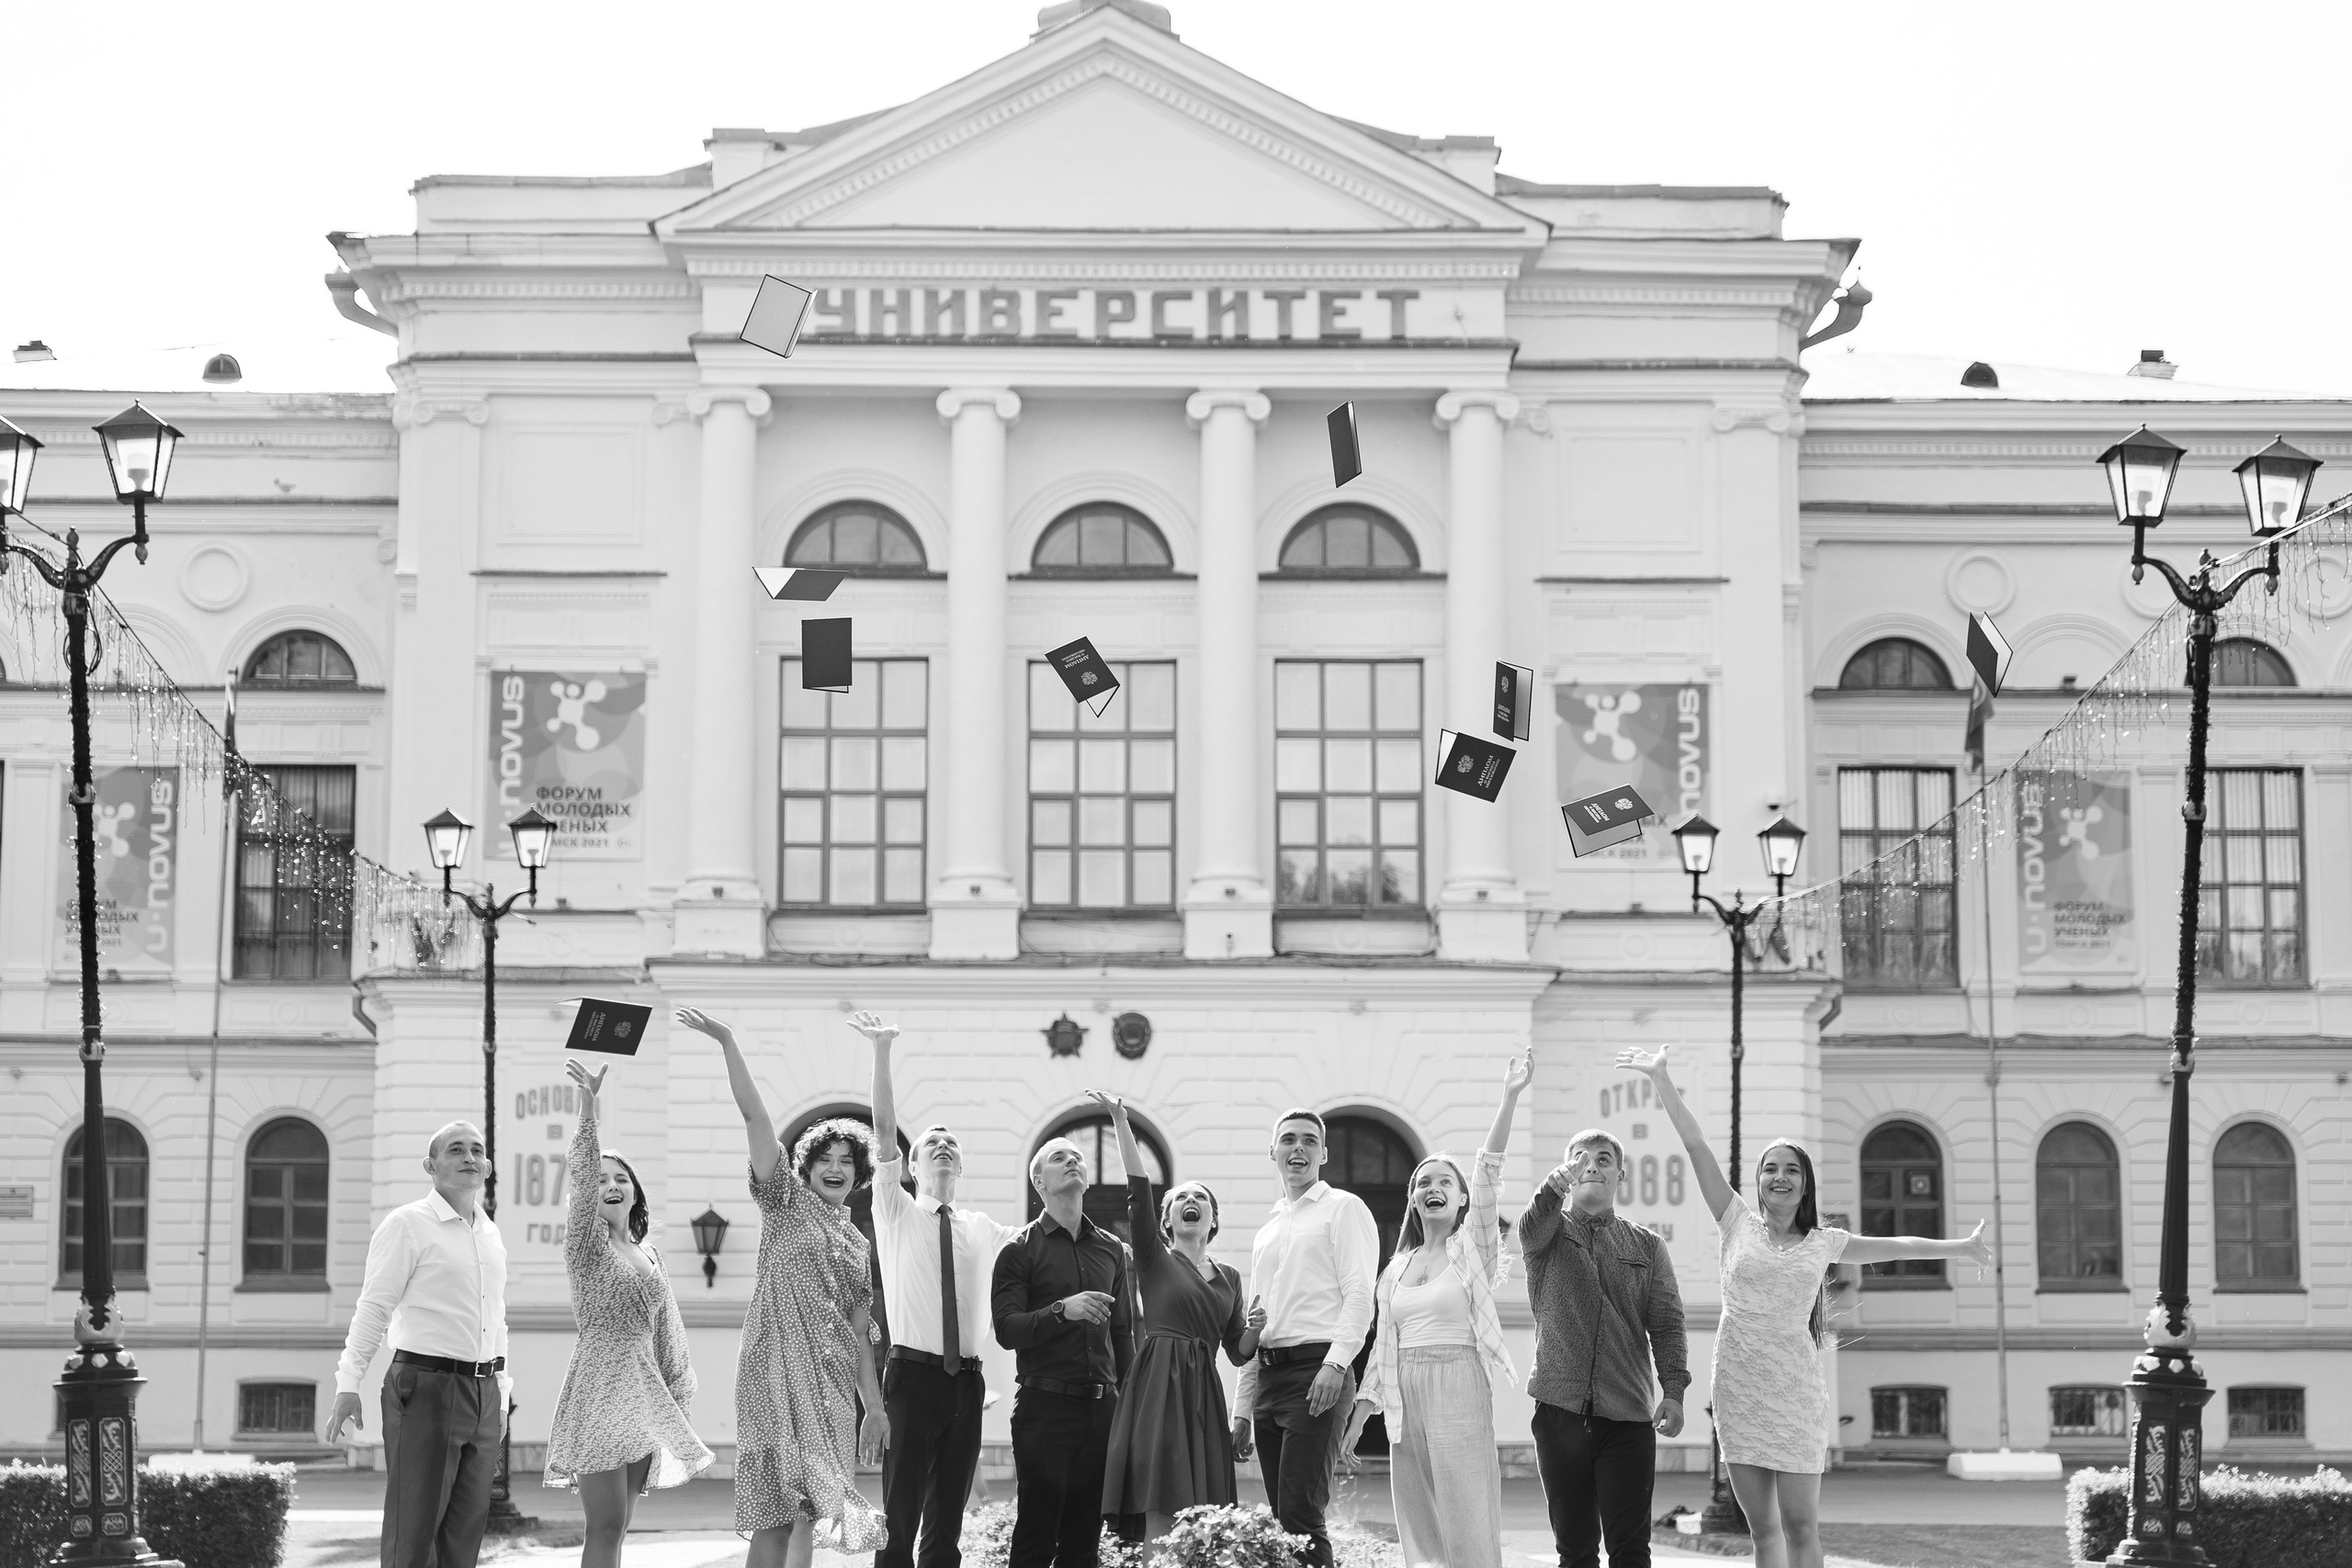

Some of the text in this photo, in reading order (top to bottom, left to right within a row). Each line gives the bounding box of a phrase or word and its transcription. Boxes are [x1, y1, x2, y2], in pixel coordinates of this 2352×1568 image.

[814, 288, 1420, 340] УНИВЕРСИТЕТ
[1064, 654, 1090, 669] ДИПЛОМ
[1477, 755, 1494, 786] ДИПЛОМ
[536, 786, 602, 801] ФОРУМ
[536, 803, 631, 818] МОЛОДЫХ
[555, 819, 608, 834] ЕНЫХ
[551, 837, 578, 848] МСК
[582, 837, 608, 848] 2021
[1620, 848, 1646, 858] 2021
[2054, 901, 2104, 911] ФОРУМ
[2054, 913, 2126, 925] МОЛОДЫХ
[2054, 926, 2109, 937] УЧЕНЫХ
[592, 1012, 606, 1041] ДИПЛОМ
[515, 1085, 600, 1119] ОСНОВ
[1600, 1078, 1685, 1118] ОТКР
[547, 1124, 563, 1139] В
[1632, 1123, 1648, 1139] В
[514, 1153, 566, 1206] 187
[1616, 1154, 1684, 1206] 888
[526, 1224, 566, 1246] ГОД
